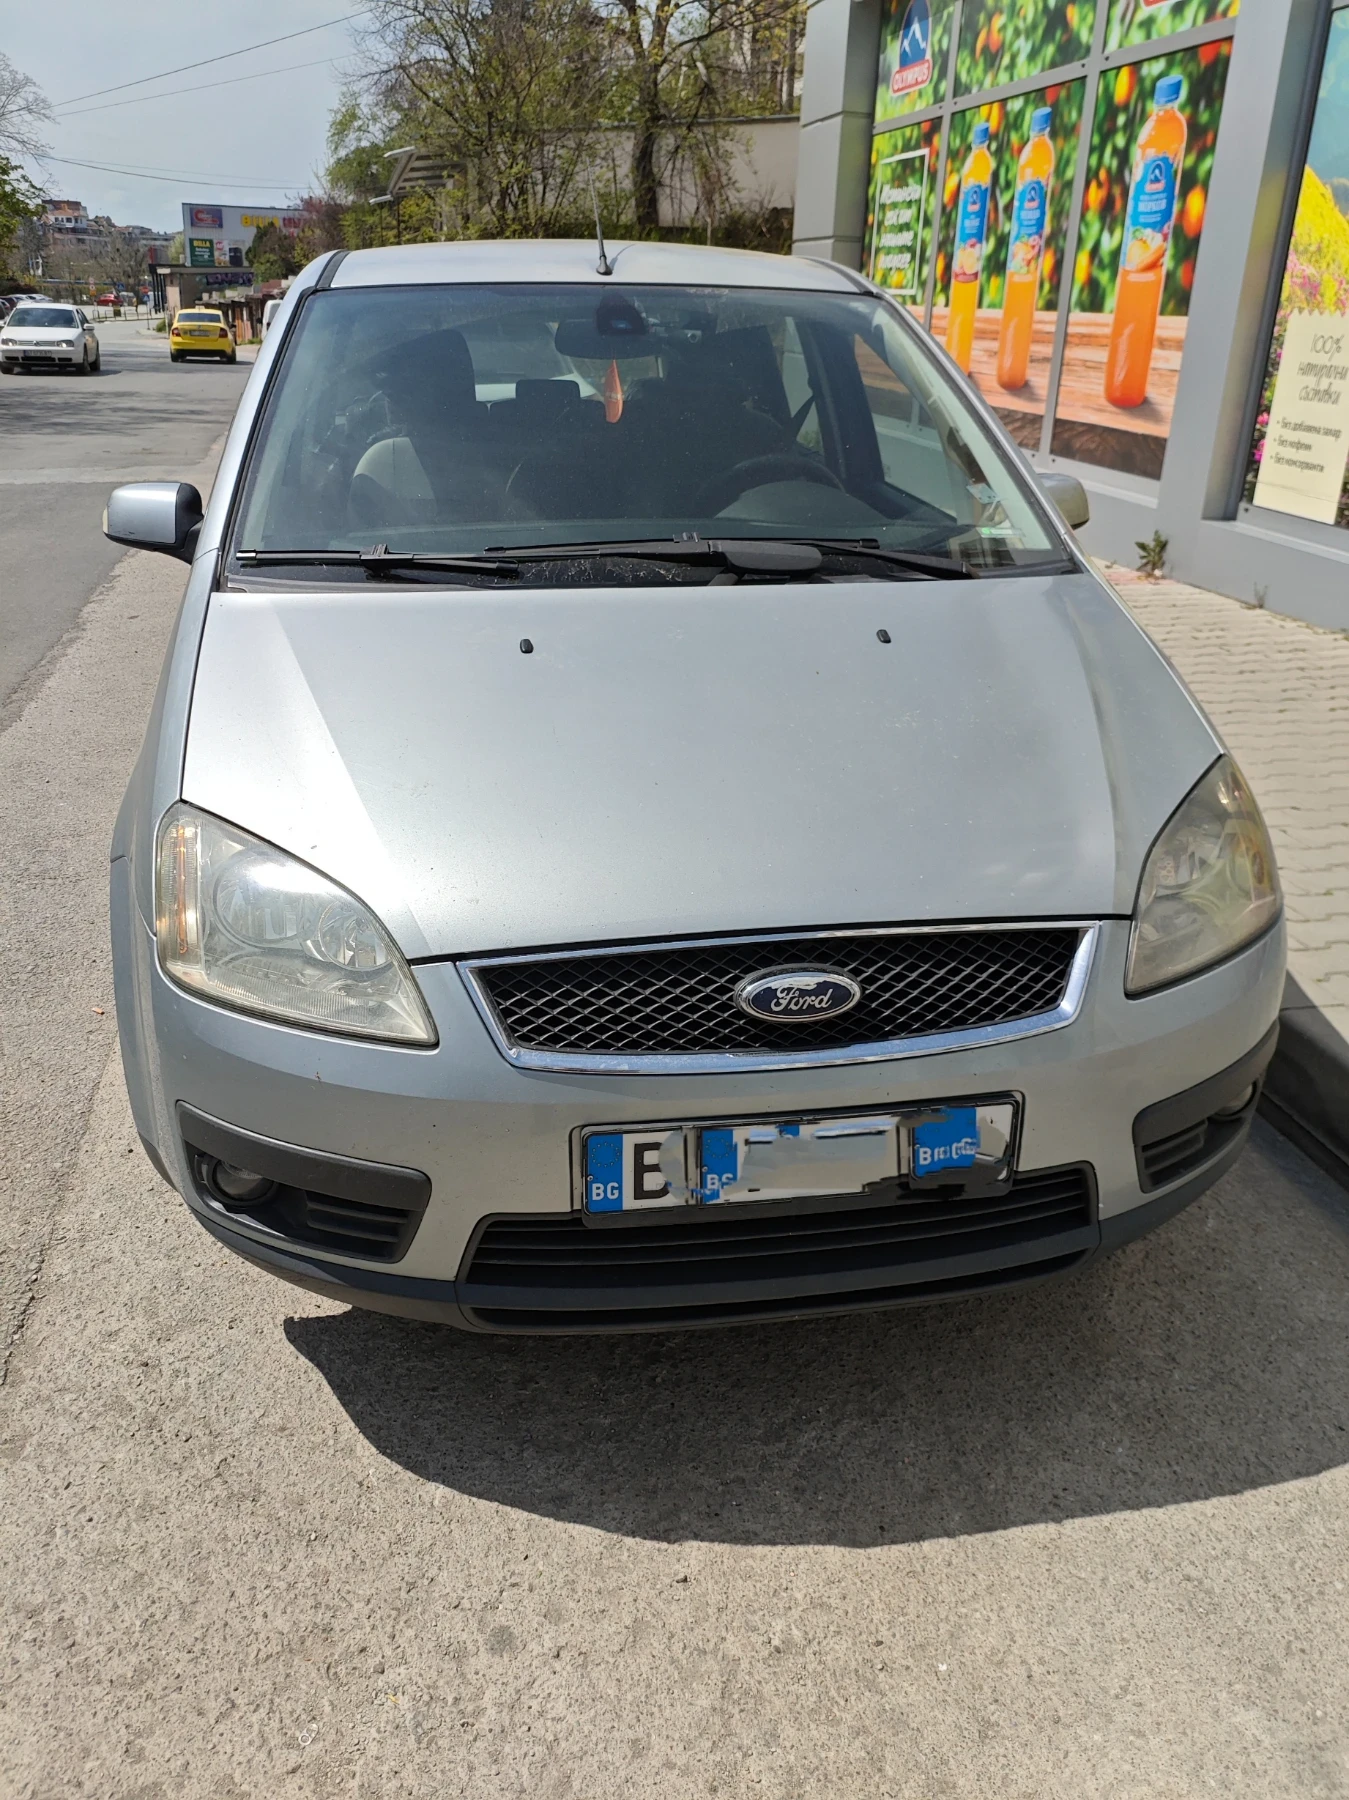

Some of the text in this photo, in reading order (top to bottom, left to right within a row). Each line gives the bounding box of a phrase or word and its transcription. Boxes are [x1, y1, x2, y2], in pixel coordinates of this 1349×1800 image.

[894, 62, 929, 90] OLYMPUS
[193, 240, 210, 248] BILLA
[1310, 333, 1344, 361] 100%
[770, 985, 833, 1011] Ford
[592, 1182, 619, 1201] BG
